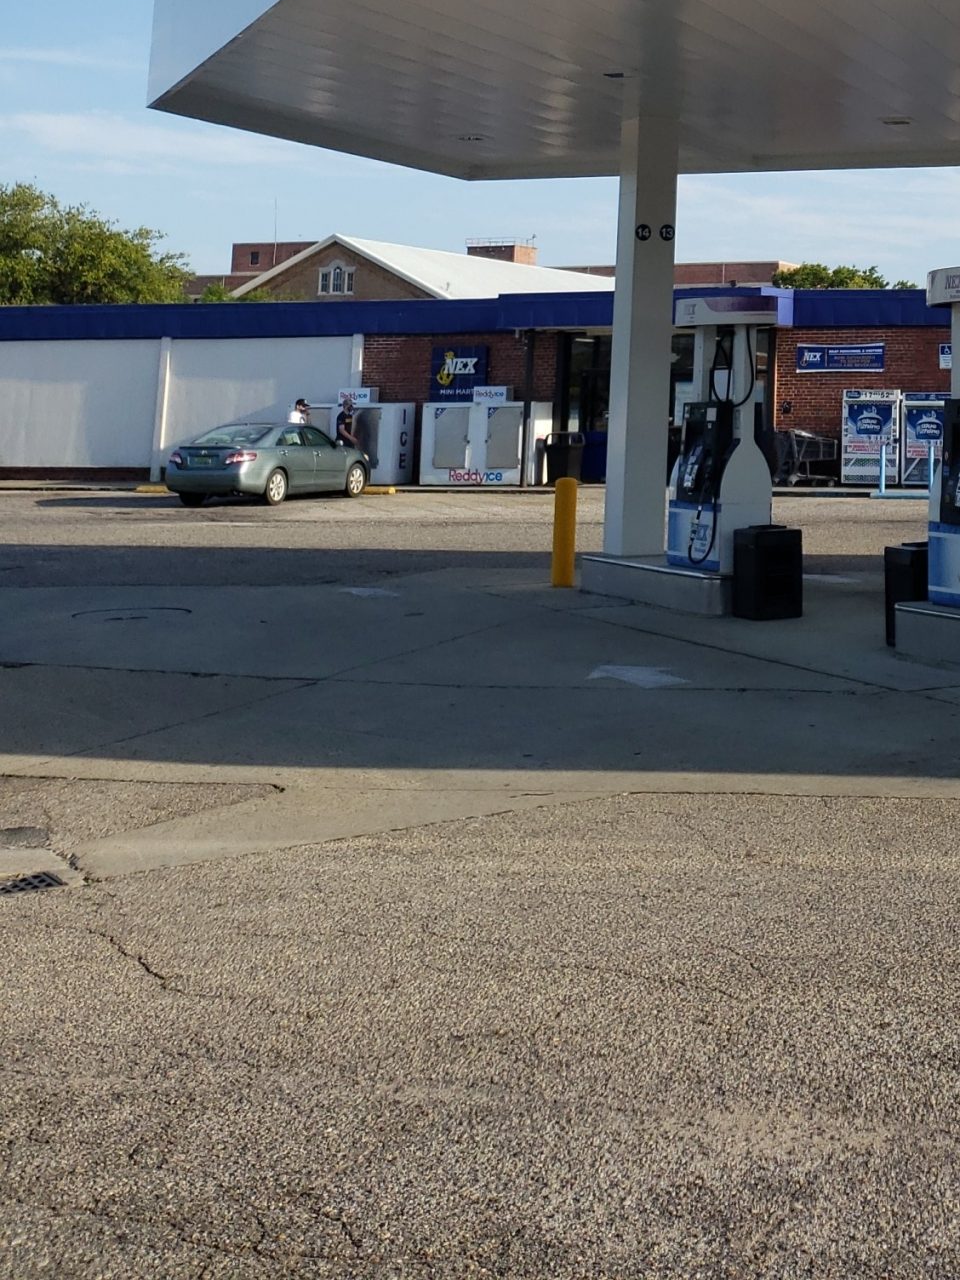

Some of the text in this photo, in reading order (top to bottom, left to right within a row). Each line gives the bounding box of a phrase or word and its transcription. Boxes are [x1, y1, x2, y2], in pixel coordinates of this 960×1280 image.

[803, 351, 822, 361] NEX
[443, 357, 478, 375] NEX
[399, 408, 407, 470] ICE
